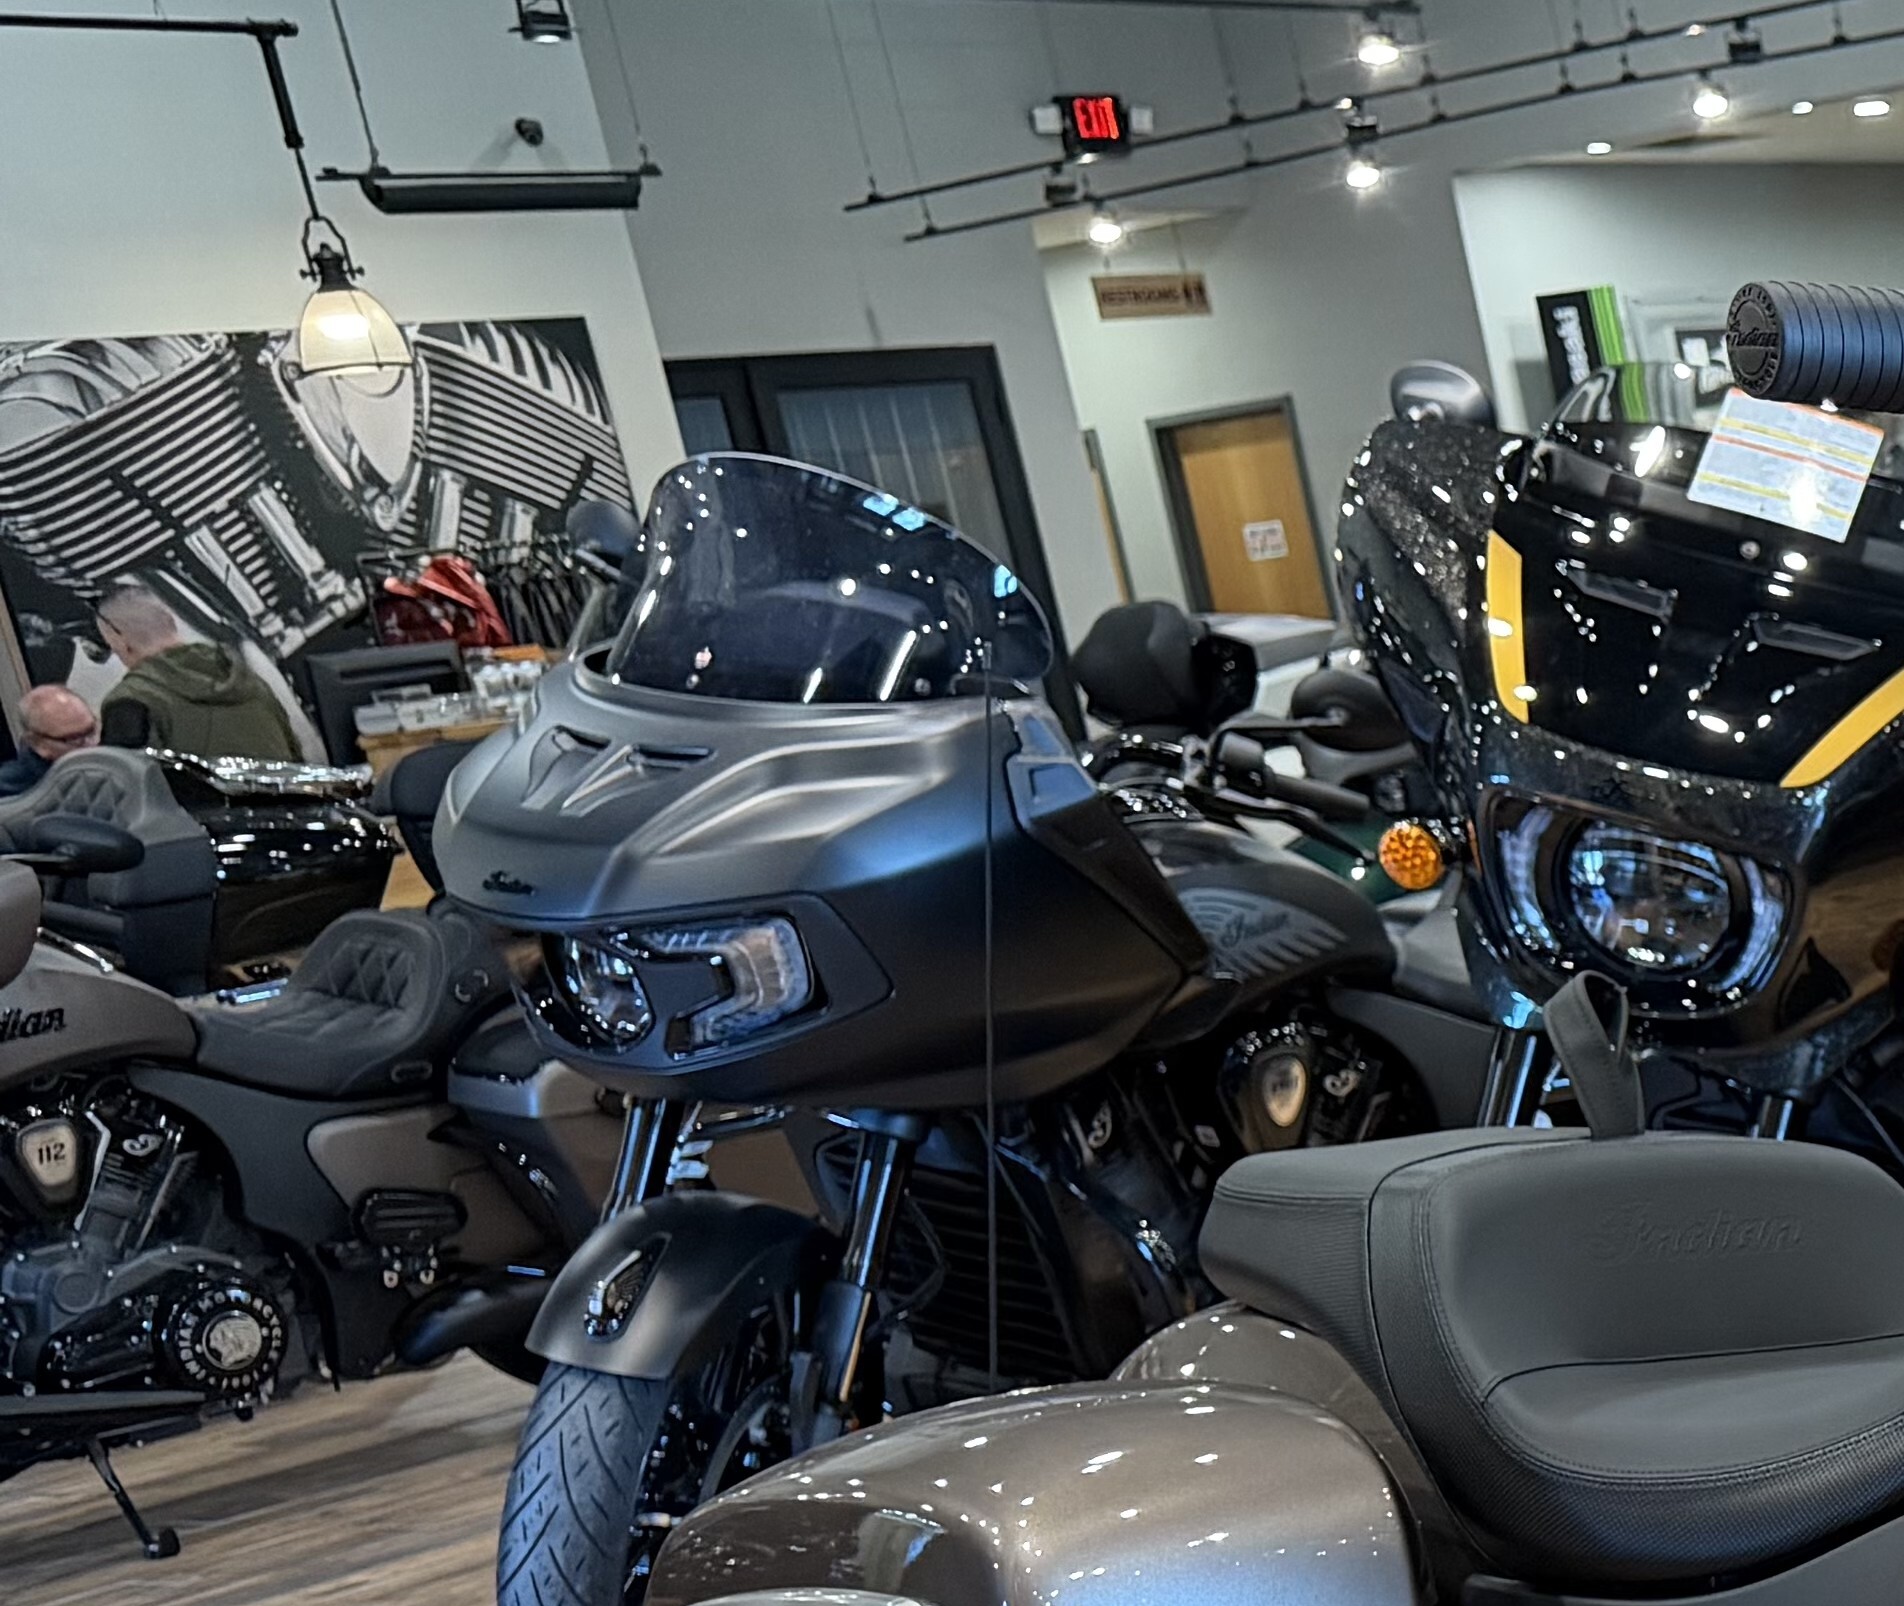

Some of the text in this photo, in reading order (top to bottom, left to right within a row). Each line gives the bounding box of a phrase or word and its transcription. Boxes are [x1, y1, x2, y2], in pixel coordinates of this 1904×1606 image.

[1072, 97, 1120, 139] EXIT
[38, 1142, 66, 1165] 112
[1594, 1197, 1806, 1265] Indian
